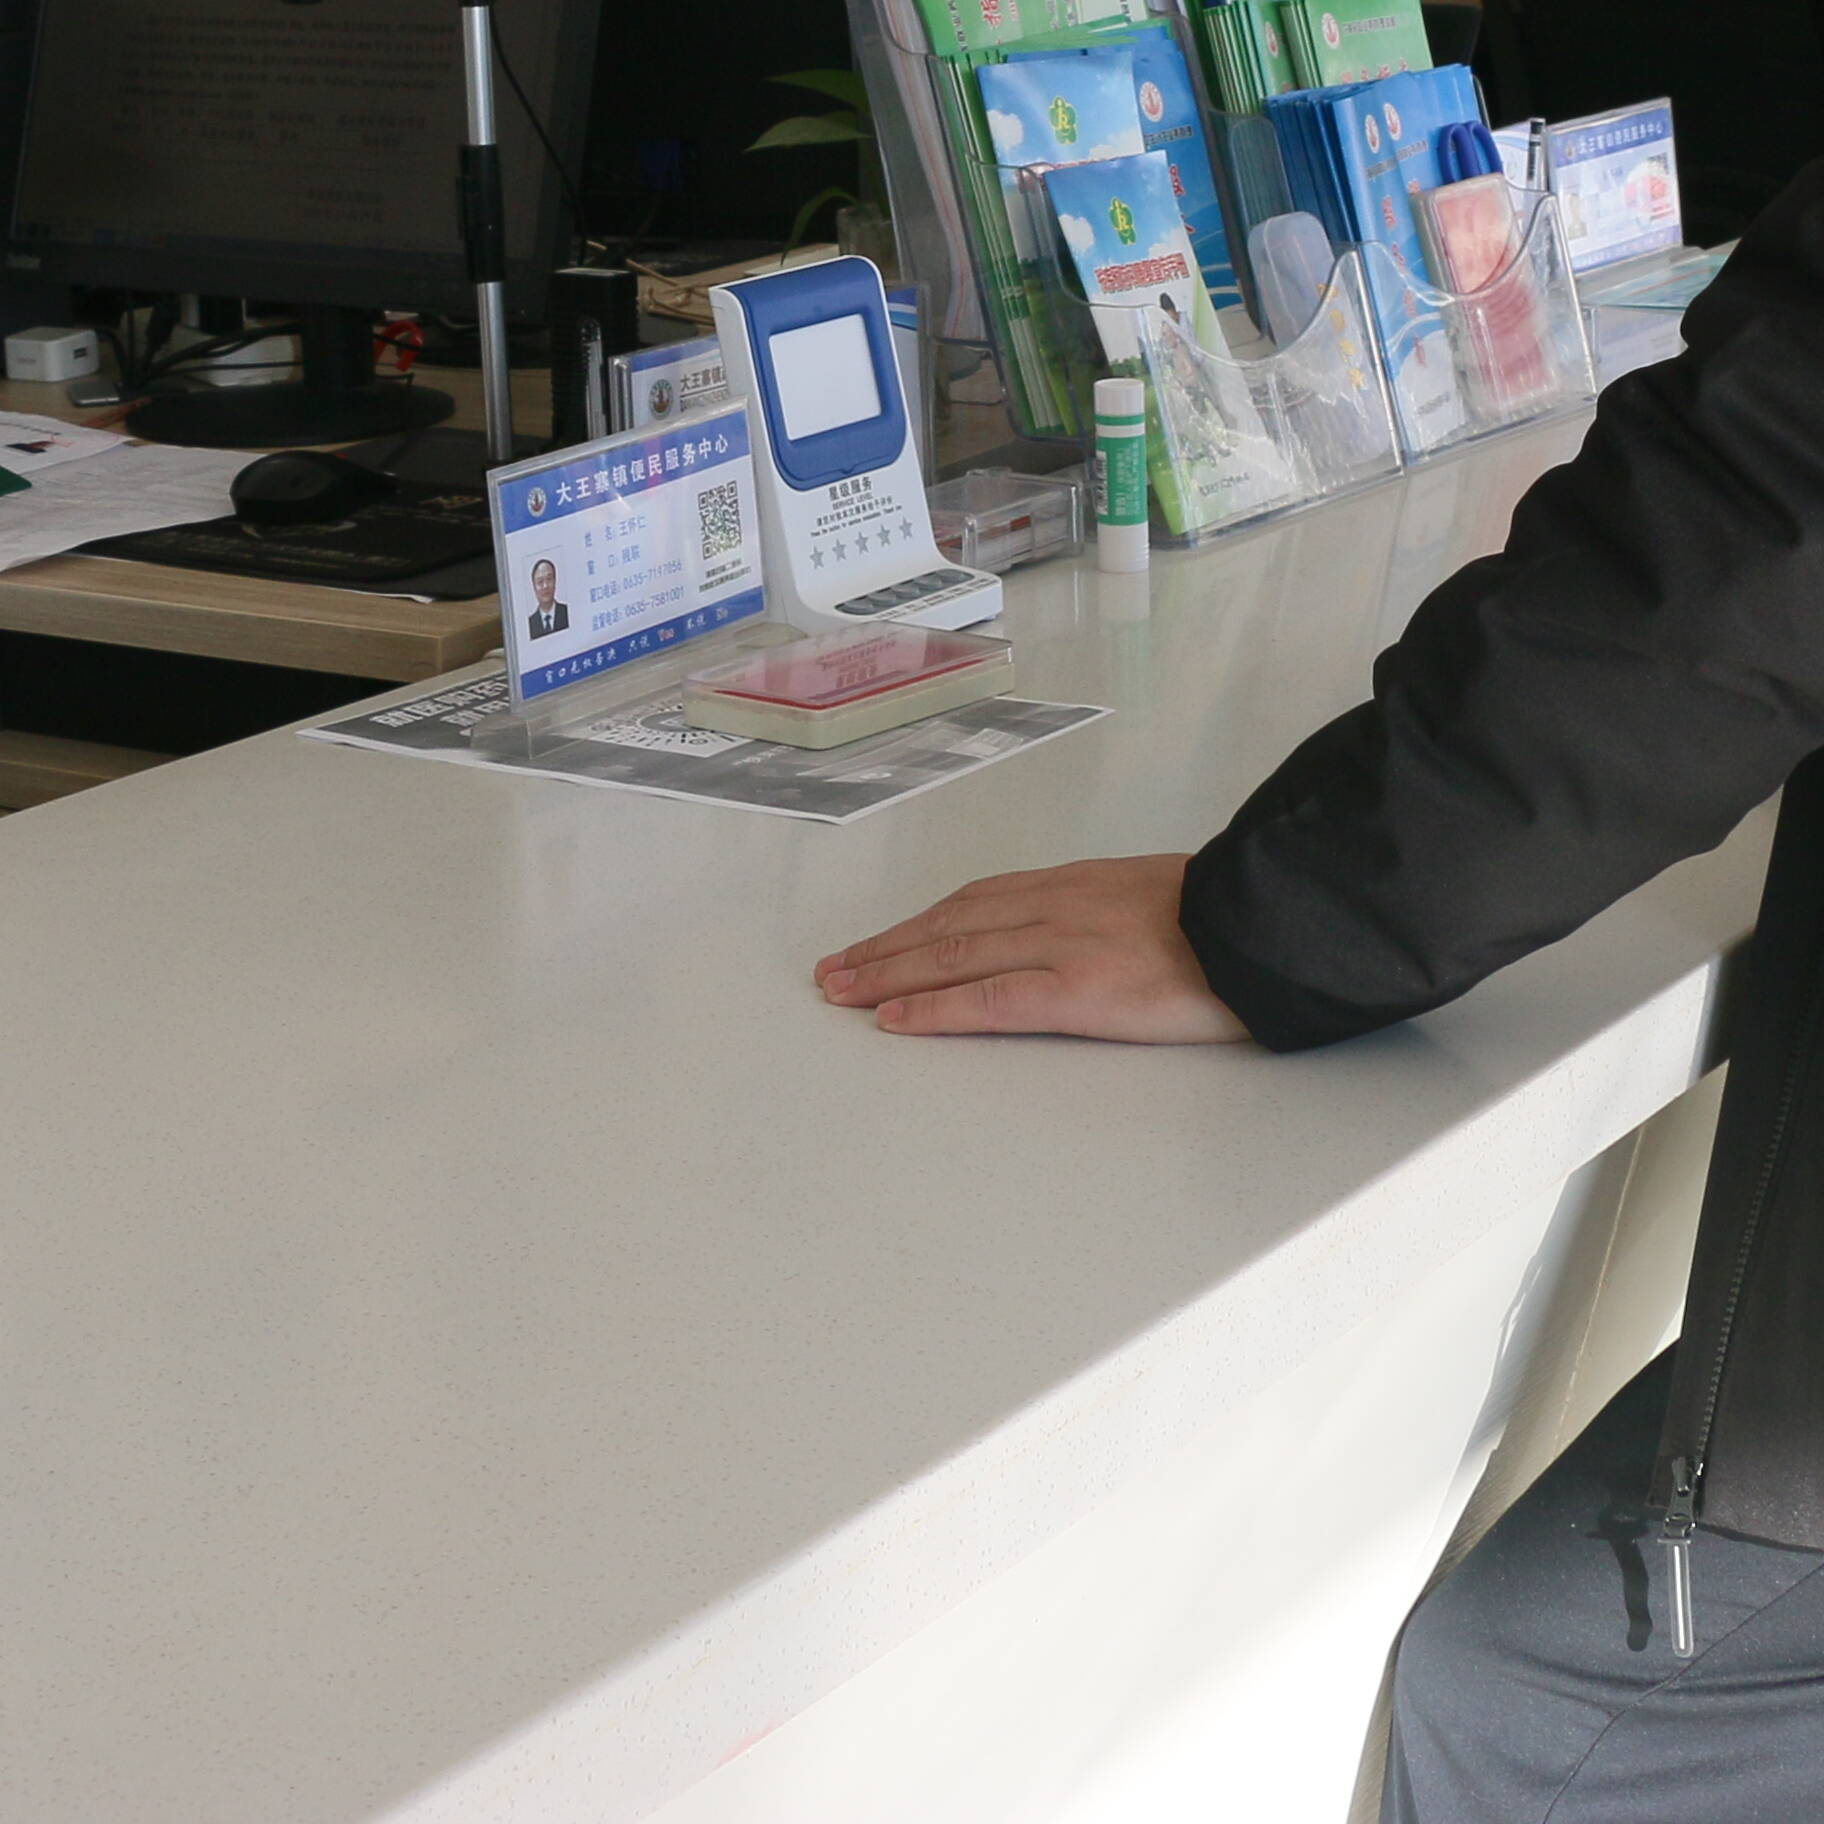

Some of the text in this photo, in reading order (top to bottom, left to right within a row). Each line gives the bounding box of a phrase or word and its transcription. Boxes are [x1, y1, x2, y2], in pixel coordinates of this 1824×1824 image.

[556, 433, 729, 506] 大王寨镇便民服务中心
[829, 477, 873, 501] 星级服务
